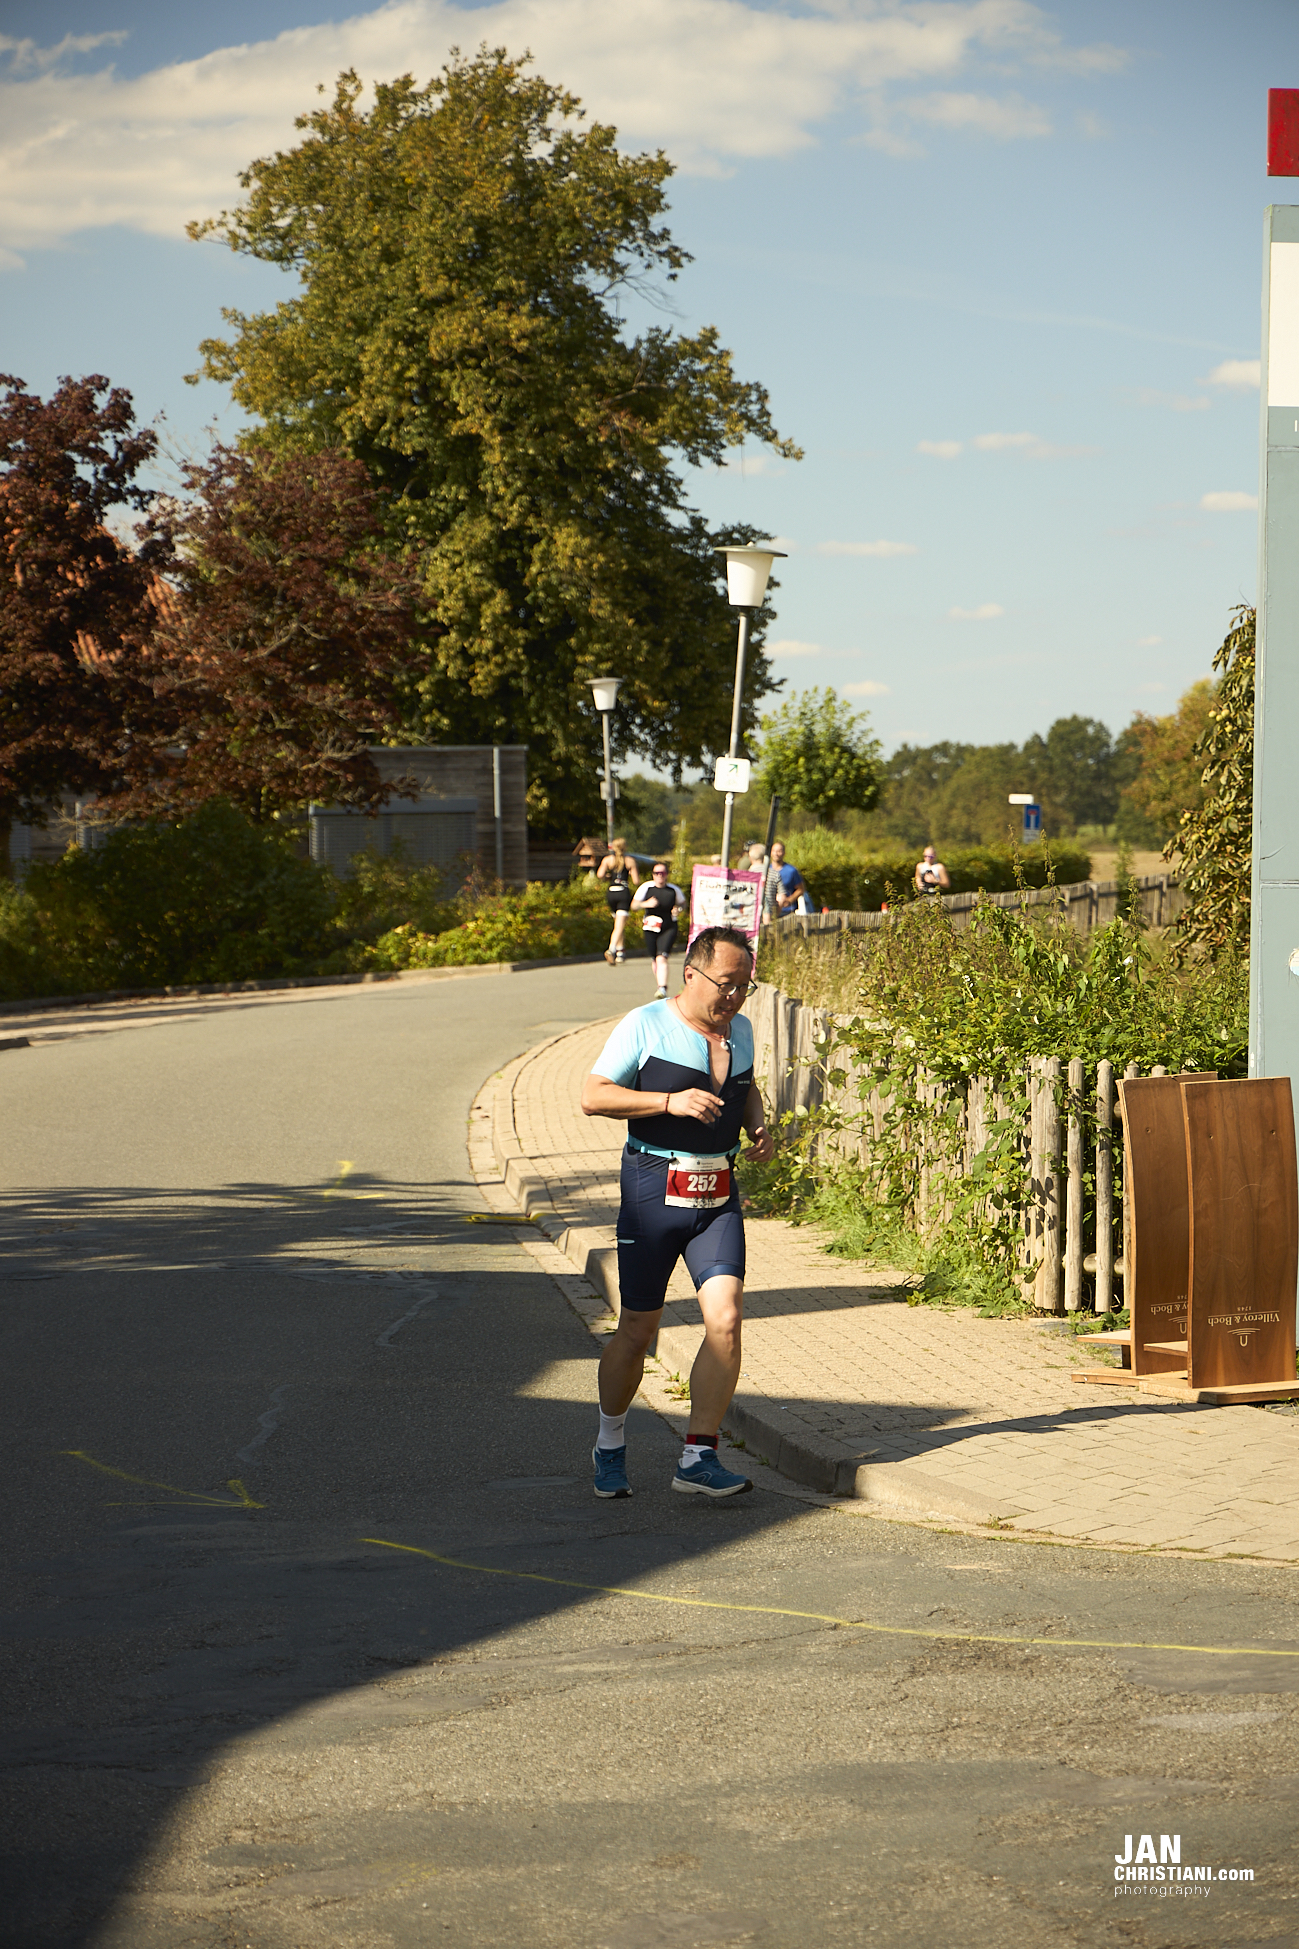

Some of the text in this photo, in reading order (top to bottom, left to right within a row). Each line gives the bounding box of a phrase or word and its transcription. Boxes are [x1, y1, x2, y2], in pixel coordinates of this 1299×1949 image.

[686, 1174, 718, 1192] 252
[1150, 1304, 1173, 1315] Boch
[1208, 1312, 1280, 1327] Villeroy & Boch
